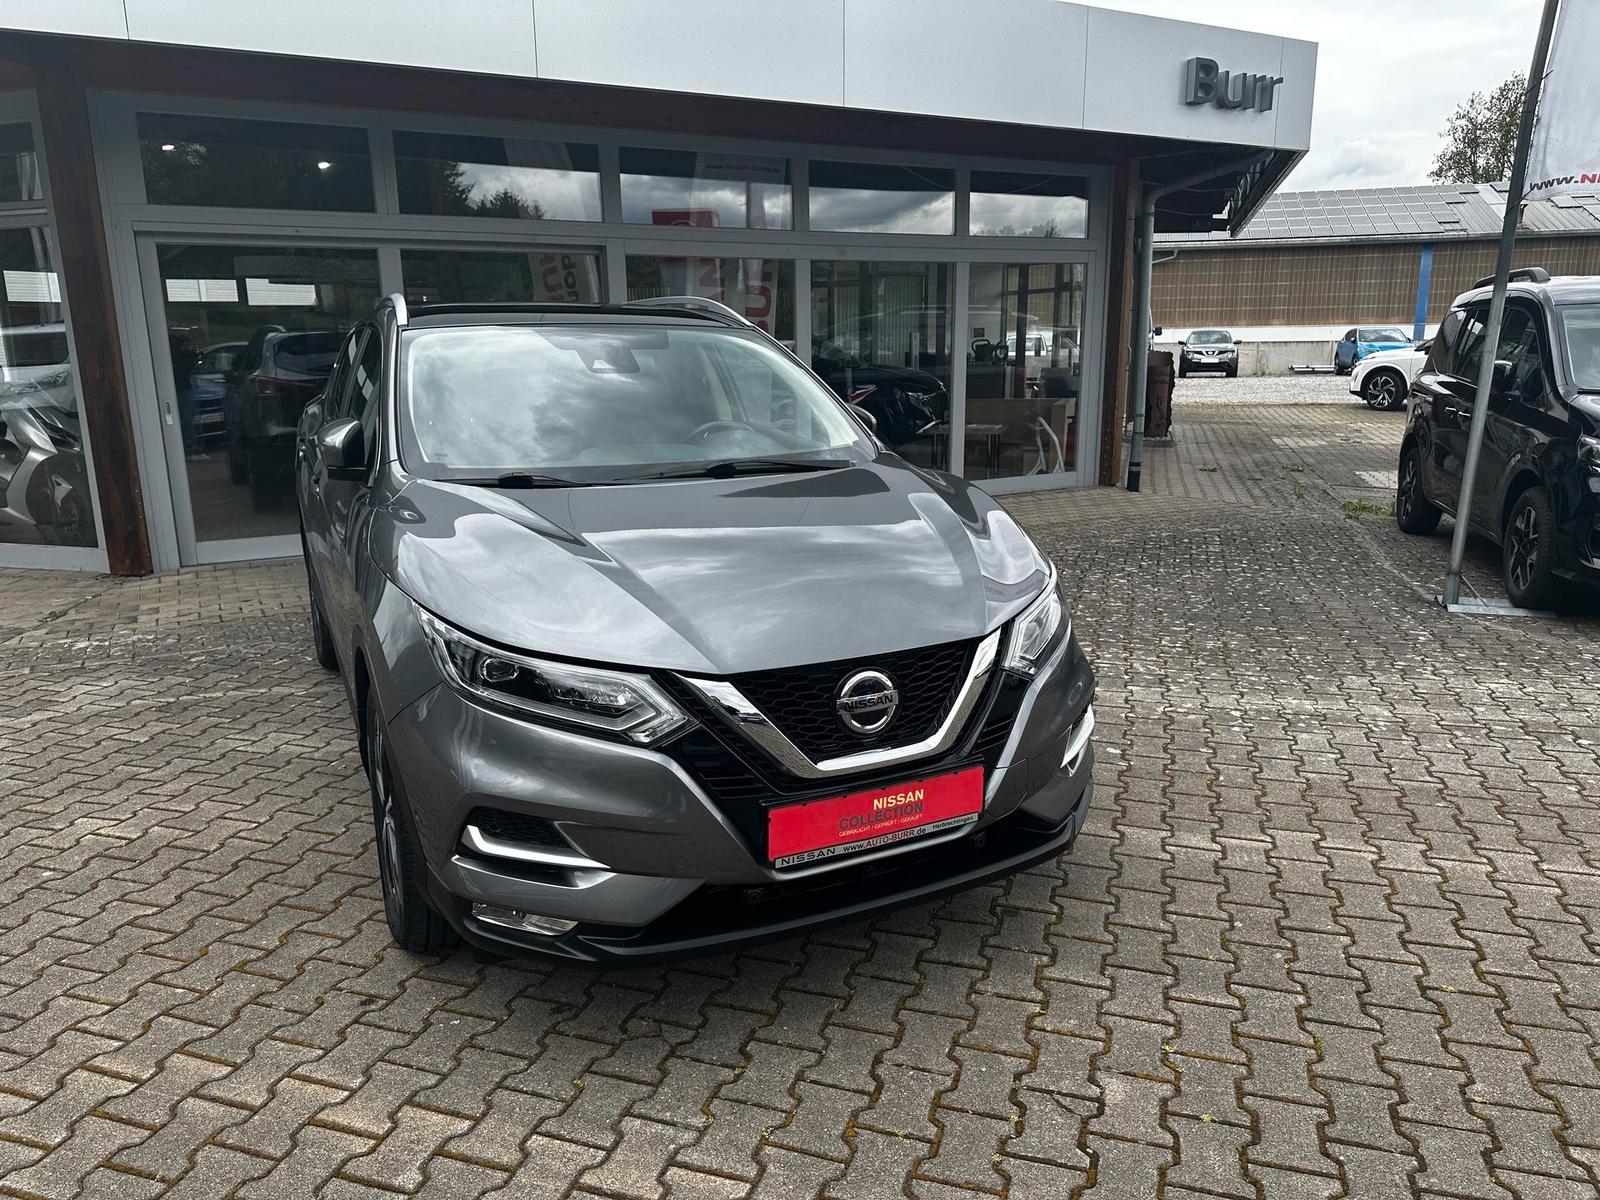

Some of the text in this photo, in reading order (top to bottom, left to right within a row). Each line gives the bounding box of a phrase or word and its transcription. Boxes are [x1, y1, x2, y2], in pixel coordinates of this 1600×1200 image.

[1185, 57, 1283, 112] Burr
[843, 694, 893, 710] NISSAN
[873, 789, 924, 810] NISSAN
[840, 802, 923, 830] COLLECTION
[780, 848, 836, 866] NISSAN
[842, 827, 927, 853] www.AUTO-BURR.de
